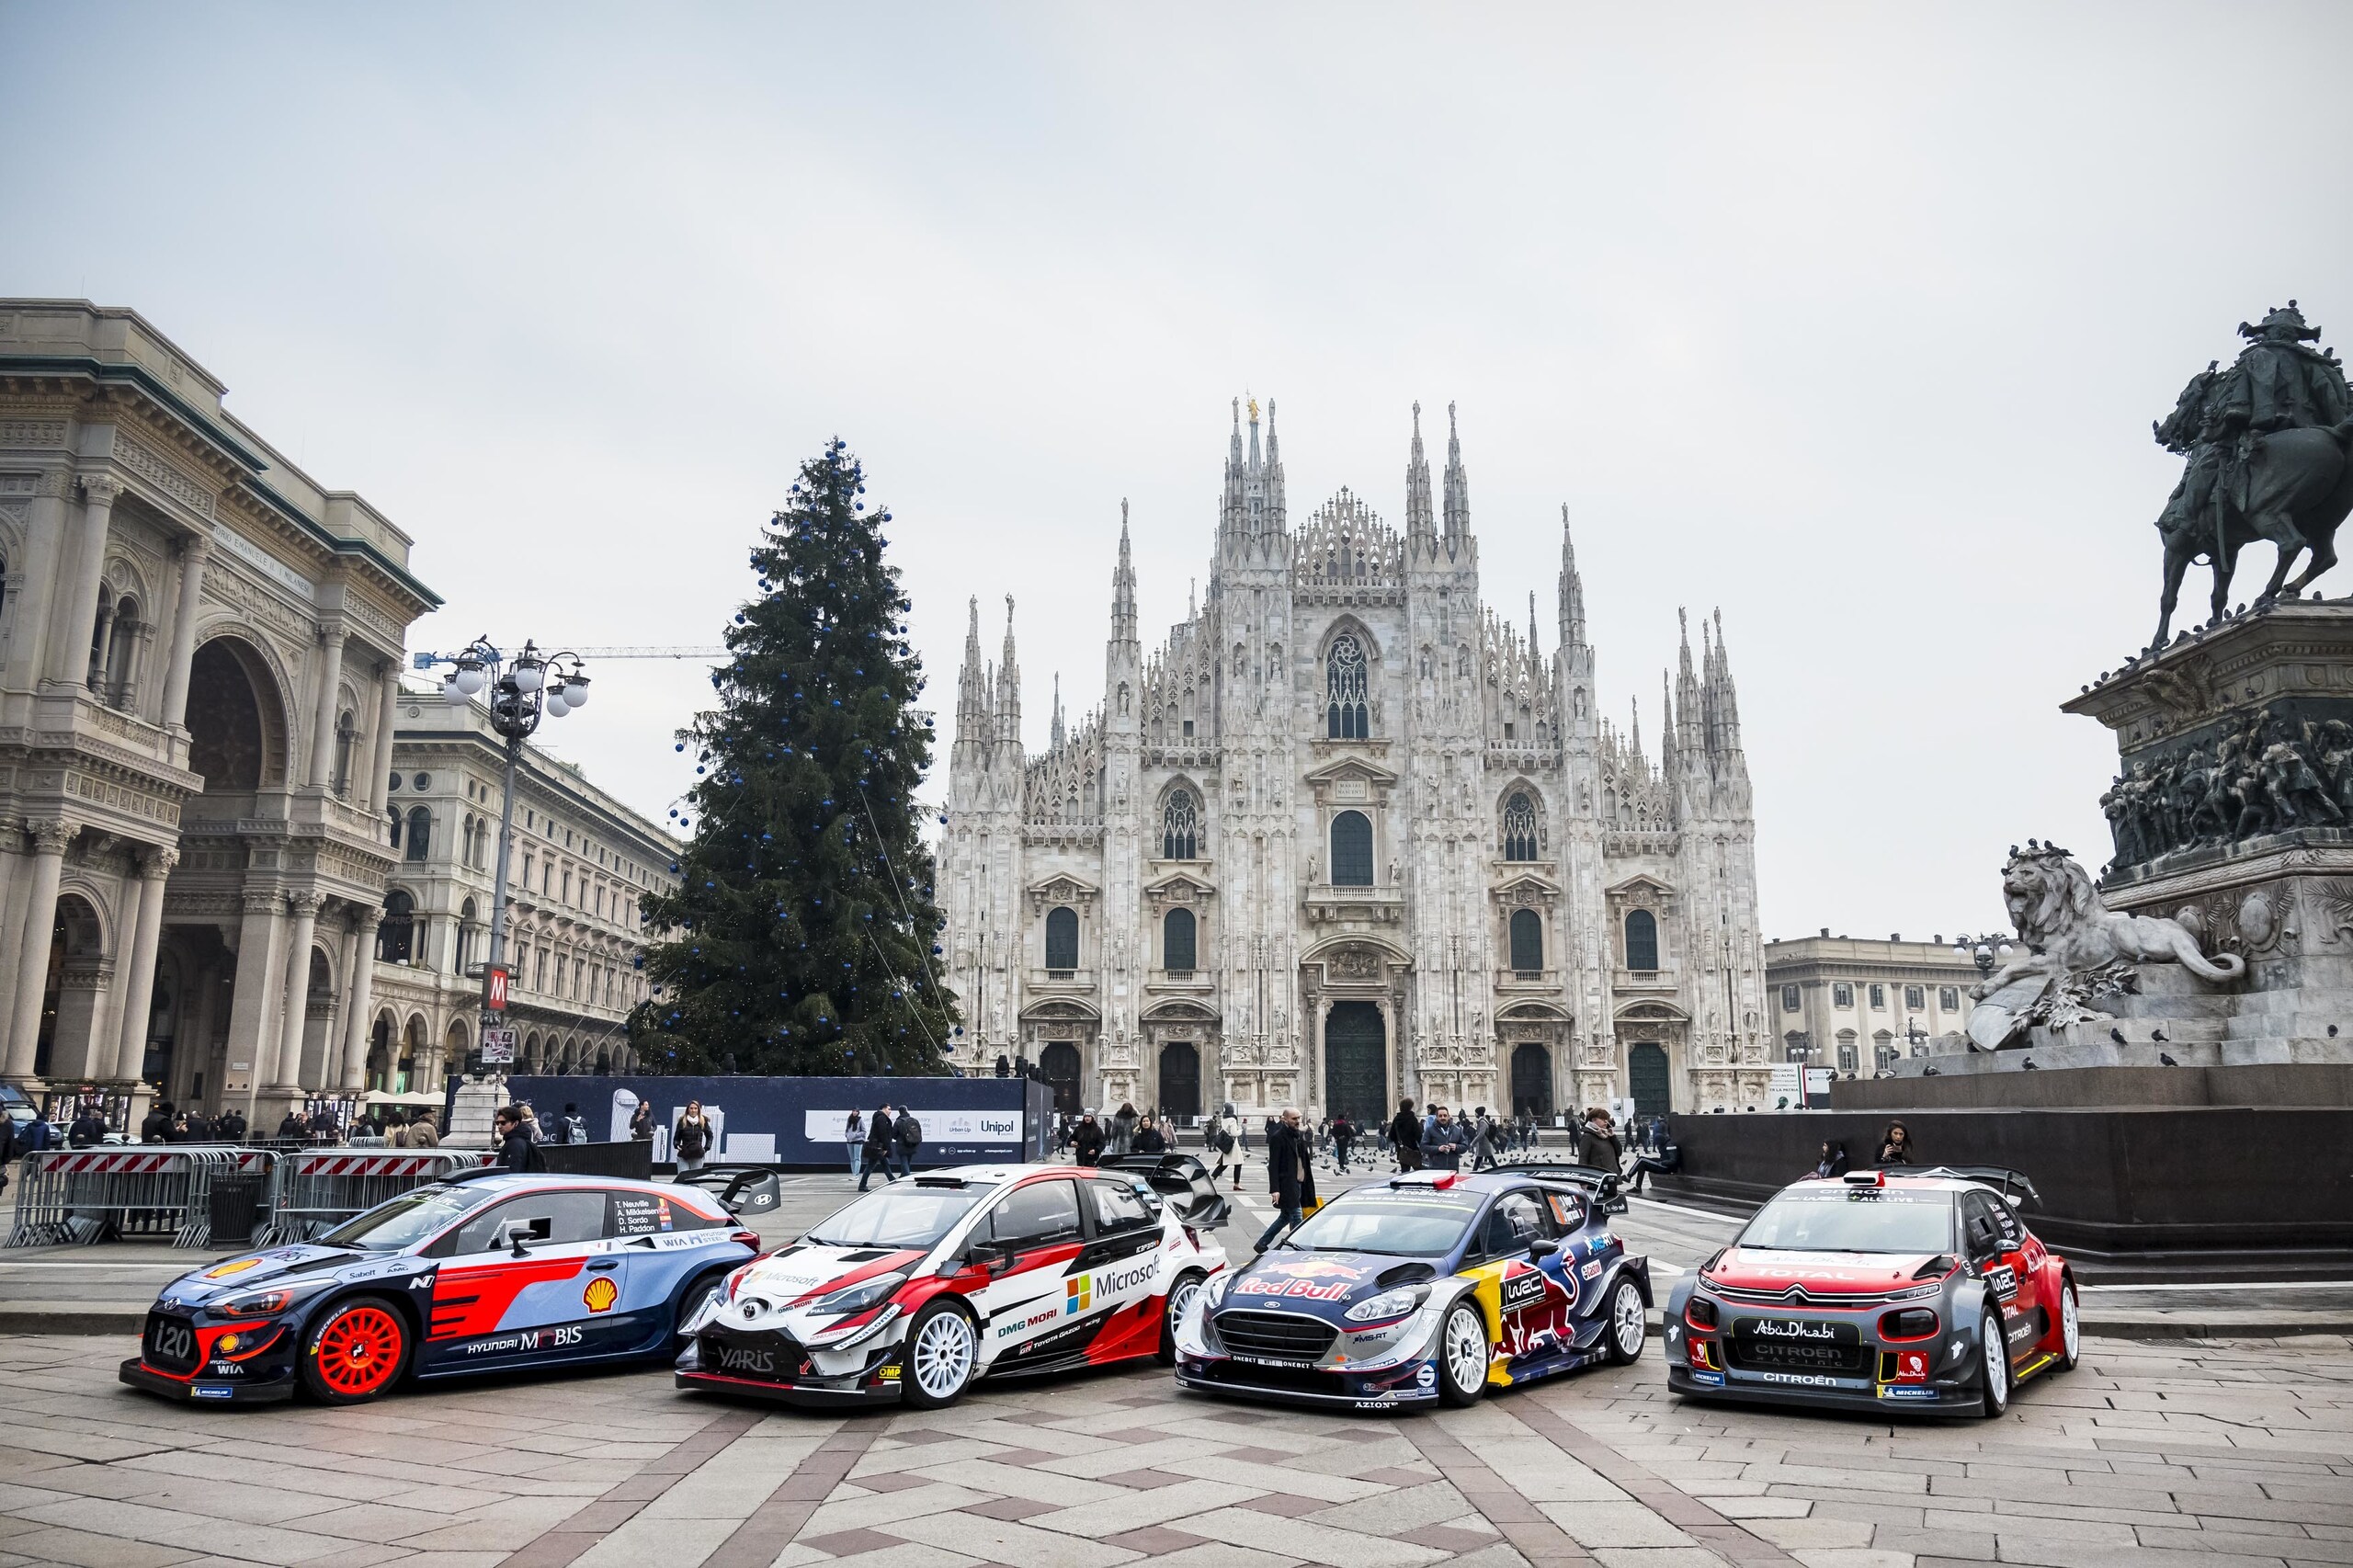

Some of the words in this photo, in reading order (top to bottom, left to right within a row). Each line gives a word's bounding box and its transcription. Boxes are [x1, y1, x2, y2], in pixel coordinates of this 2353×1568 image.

[215, 527, 233, 543] ORIO
[234, 538, 267, 567] EMANUELE
[284, 571, 310, 594] MILANESI
[490, 975, 505, 1002] M
[981, 1120, 1014, 1135] Unipol
[429, 1196, 496, 1237] motorsport.hyundai.com
[628, 1216, 648, 1224] Sordo
[630, 1224, 655, 1233] Paddon
[349, 1269, 376, 1279] Sabelt
[763, 1272, 819, 1287] Microsoft
[1097, 1254, 1161, 1299] Microsoft
[1756, 1267, 1855, 1280] TOTAL
[1992, 1271, 2016, 1292] WRC
[1235, 1277, 1290, 1295] Red
[1285, 1278, 1352, 1301] Bull
[1507, 1275, 1542, 1299] WRC
[794, 1300, 813, 1309] MORI
[2001, 1304, 2019, 1321] OTAL
[318, 1306, 348, 1340] MICHELIN
[839, 1309, 897, 1348] Panasonic
[997, 1321, 1026, 1339] DMG
[1027, 1309, 1058, 1327] MORI
[1754, 1320, 1784, 1335] Abu
[1788, 1321, 1836, 1339] Dhabi
[155, 1320, 191, 1358] i20
[809, 1331, 848, 1342] KONECRANES
[1033, 1335, 1058, 1349] TOYOTA
[1059, 1325, 1081, 1338] GAZOO
[1081, 1317, 1101, 1330] Racing
[1358, 1332, 1388, 1343] MS-RT
[468, 1338, 518, 1355] HYUNDAI
[1349, 1358, 1397, 1369] MICHELIN
[879, 1369, 901, 1377] OMP
[1695, 1373, 1720, 1381] MICHELIN
[1763, 1373, 1836, 1386] CITROËN
